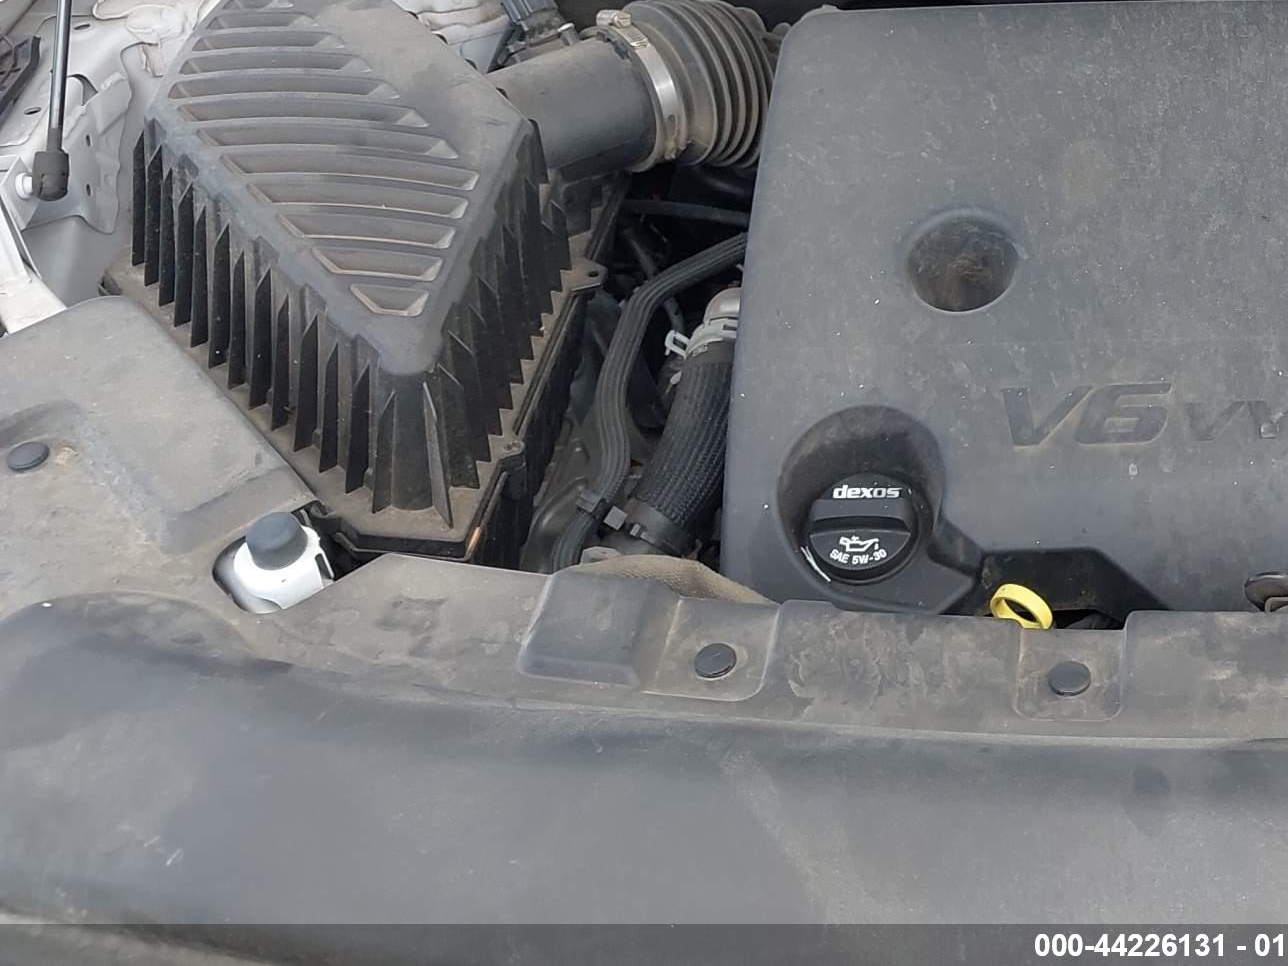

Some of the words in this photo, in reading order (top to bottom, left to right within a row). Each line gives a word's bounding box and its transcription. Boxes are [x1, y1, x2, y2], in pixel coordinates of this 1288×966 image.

[1000, 382, 1172, 448] V6
[832, 484, 902, 499] dexos
[830, 548, 850, 564] SAE
[852, 549, 887, 564] 5W-30
